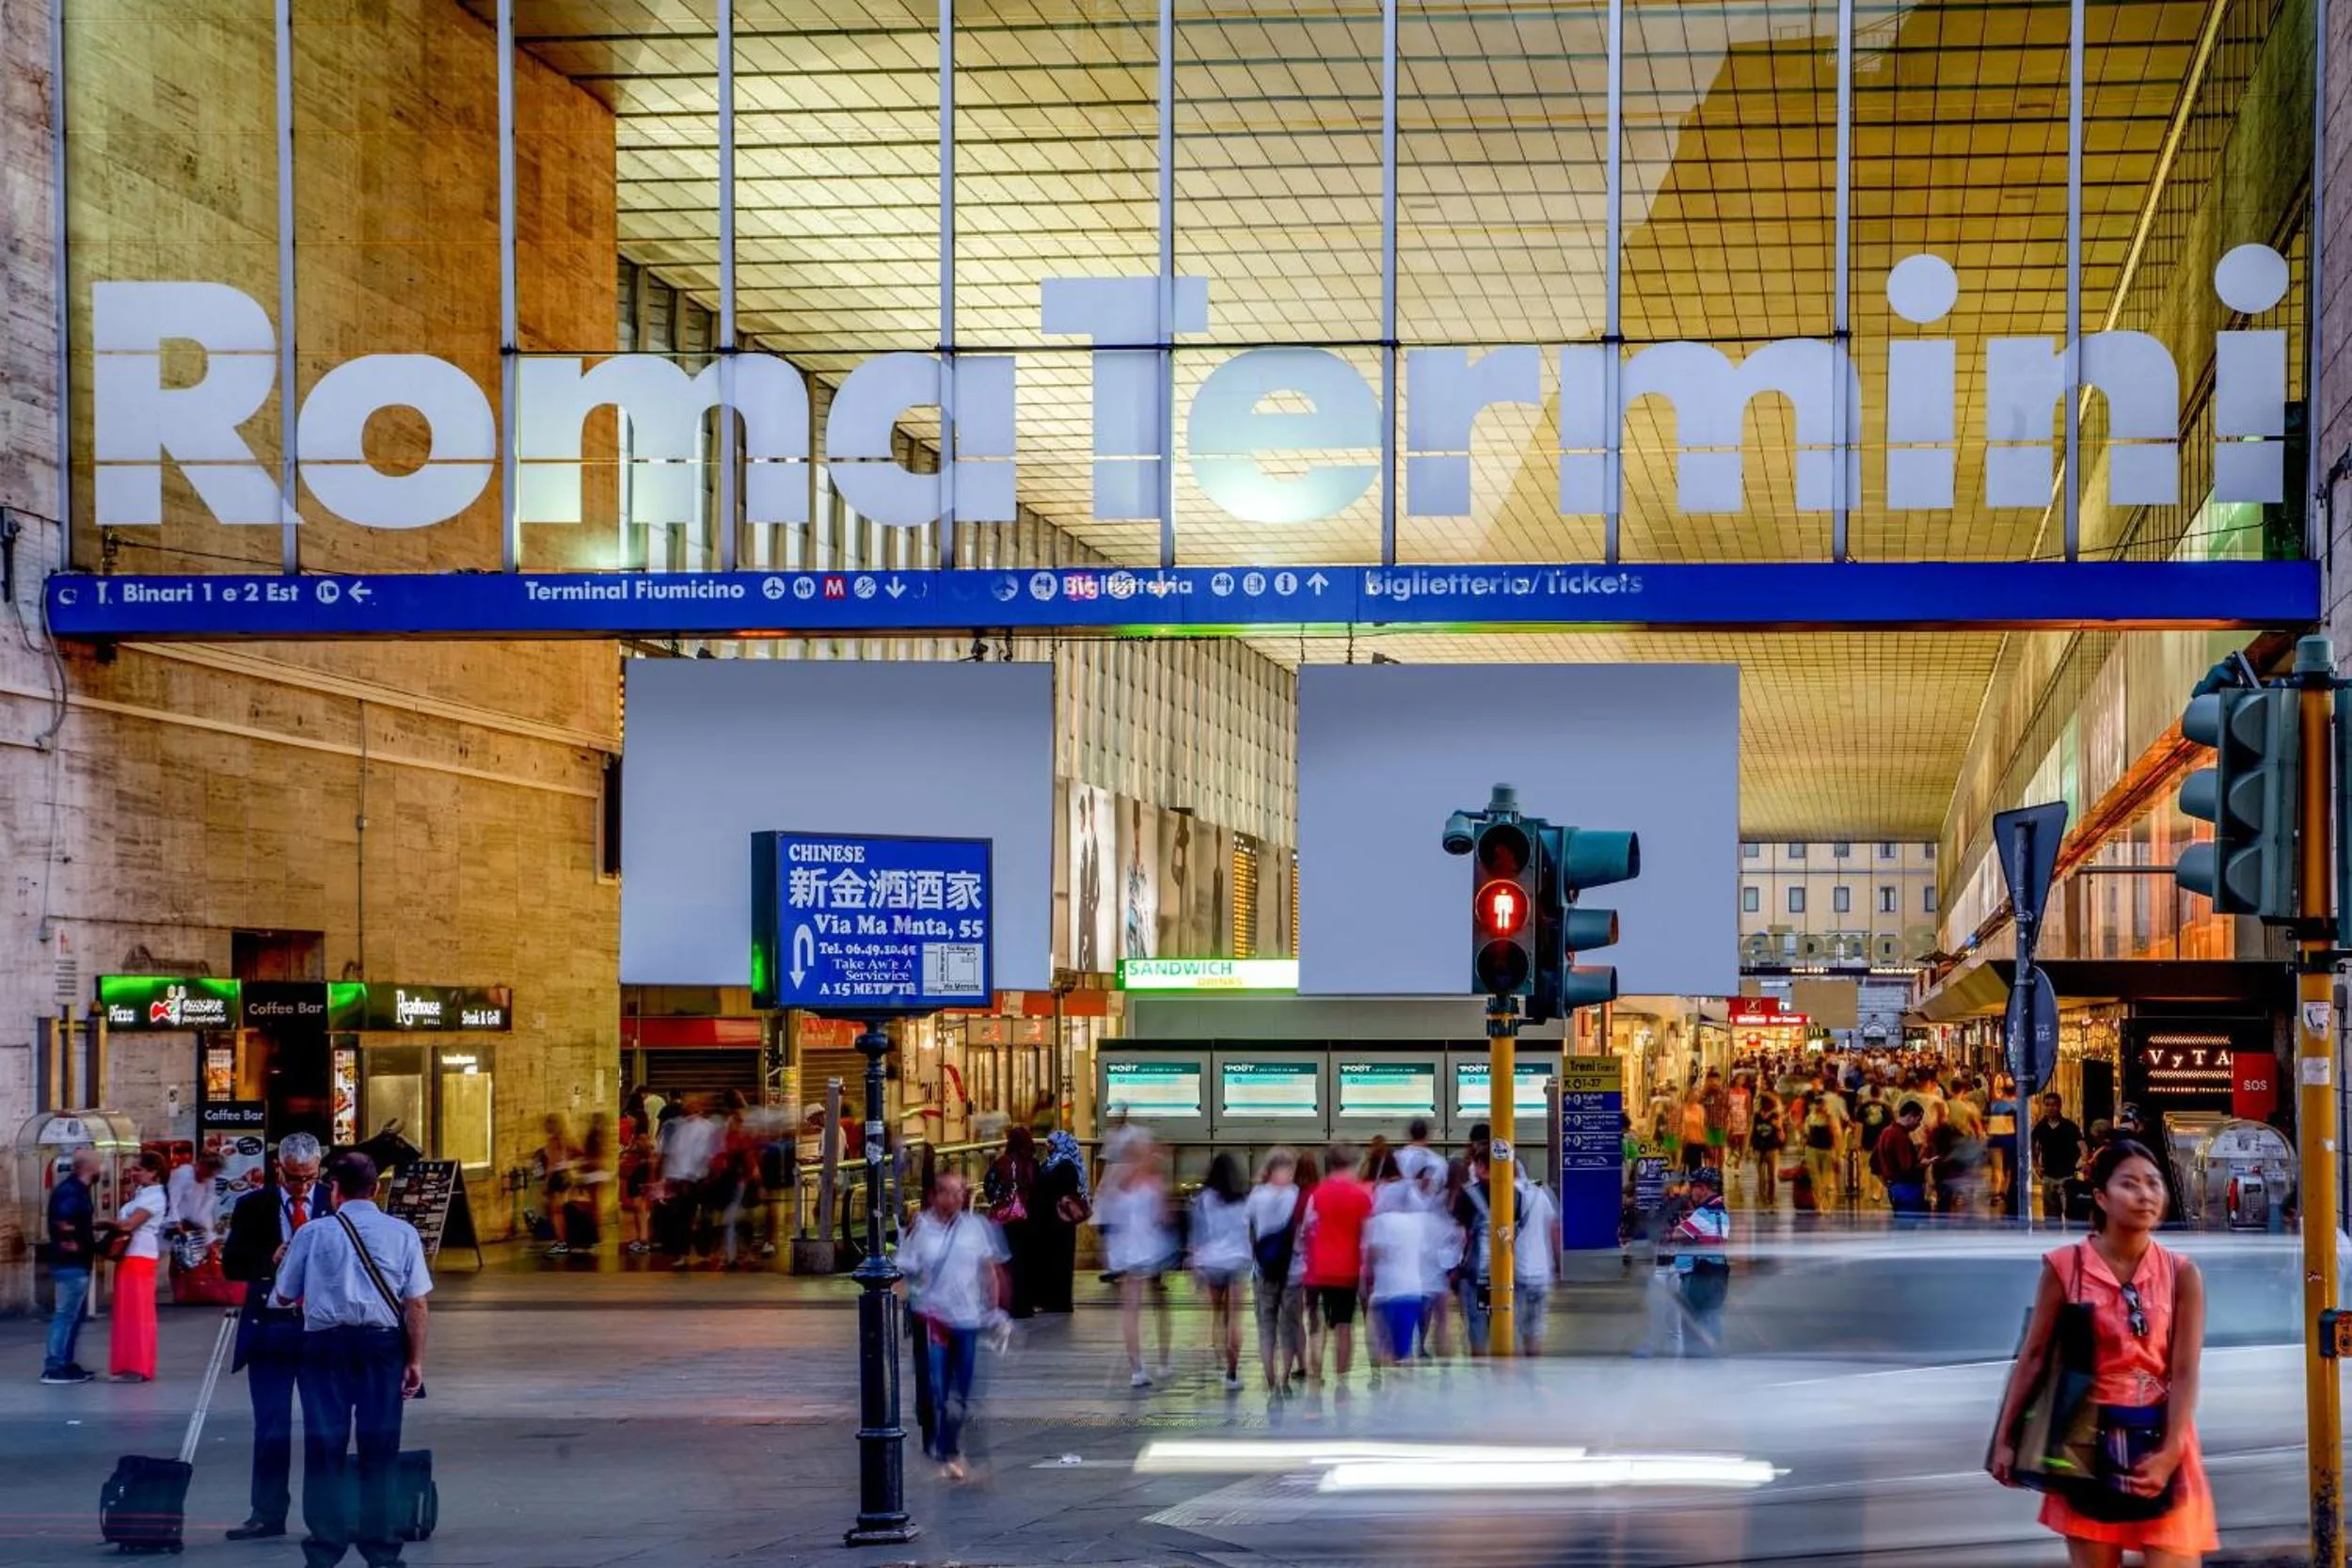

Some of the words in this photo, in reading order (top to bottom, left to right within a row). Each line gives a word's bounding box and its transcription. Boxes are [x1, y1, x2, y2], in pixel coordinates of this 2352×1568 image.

[123, 582, 193, 602] Binari
[202, 583, 213, 602] 1
[223, 587, 237, 602] e
[244, 583, 260, 602] 2
[266, 583, 299, 602] Est
[525, 581, 628, 600] Terminal
[635, 580, 745, 599] Fiumicino
[788, 844, 866, 863] CHINESE
[814, 913, 851, 935] Via
[959, 919, 984, 939] 55
[818, 942, 843, 955] Tel.
[832, 958, 865, 970] Take
[1129, 962, 1233, 976] SANDWICH
[819, 983, 831, 995] A
[833, 983, 850, 996] 15
[109, 1005, 135, 1022] Pizza
[248, 1002, 293, 1014] Coffee
[297, 1002, 323, 1014] Bar
[396, 990, 441, 1025] Roadhouse
[462, 1010, 479, 1024] Steak
[486, 1009, 501, 1024] Grill
[2243, 1080, 2267, 1090] SOS
[204, 1110, 241, 1121] Coffee
[244, 1110, 264, 1121] Bar
